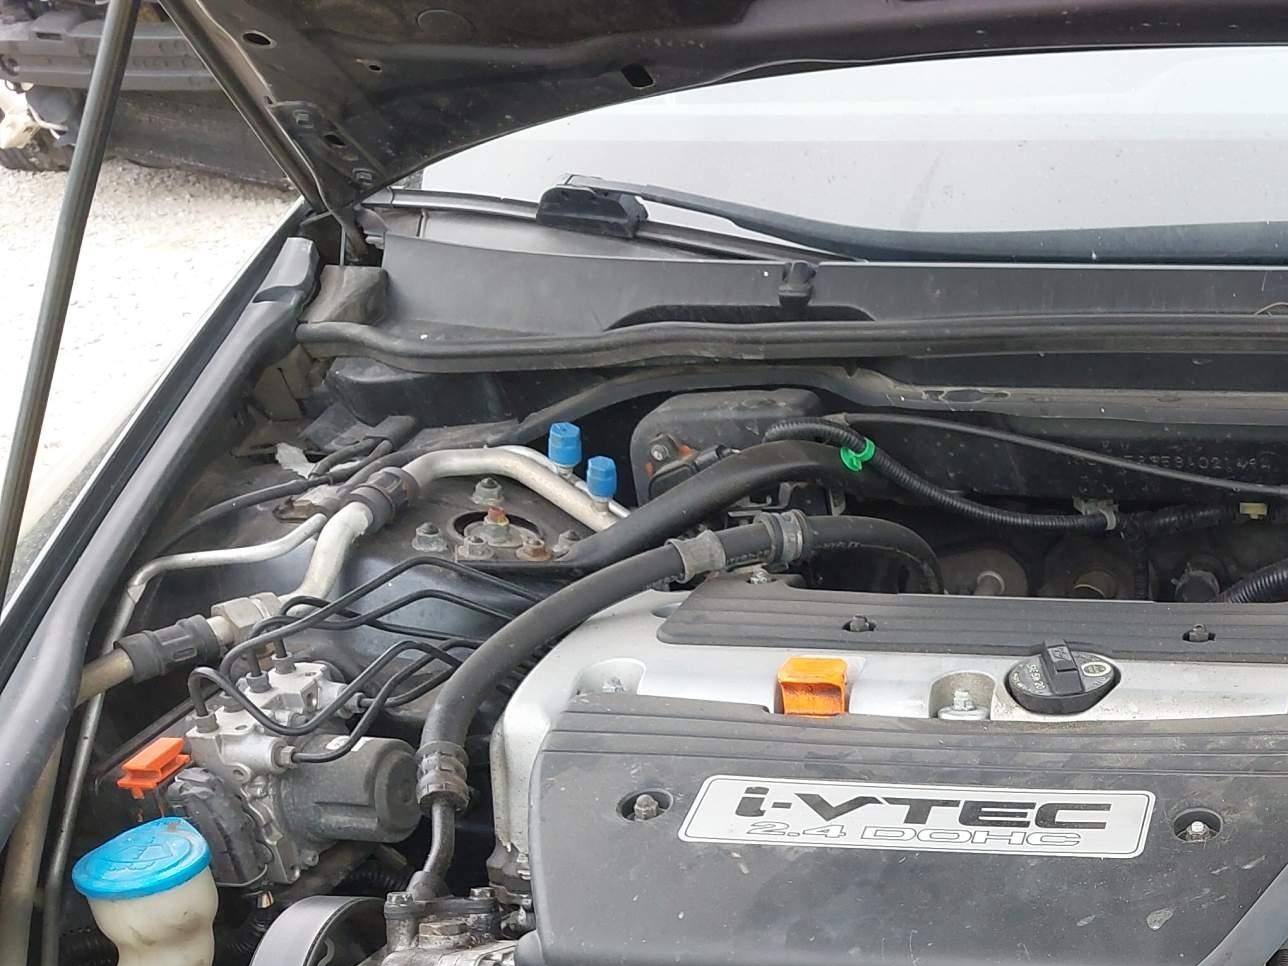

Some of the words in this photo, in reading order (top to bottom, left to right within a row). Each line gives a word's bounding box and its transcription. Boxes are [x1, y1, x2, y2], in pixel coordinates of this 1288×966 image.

[735, 786, 1113, 830] i-VTEC
[747, 820, 847, 839] 2.4
[861, 826, 1081, 847] DOHC
